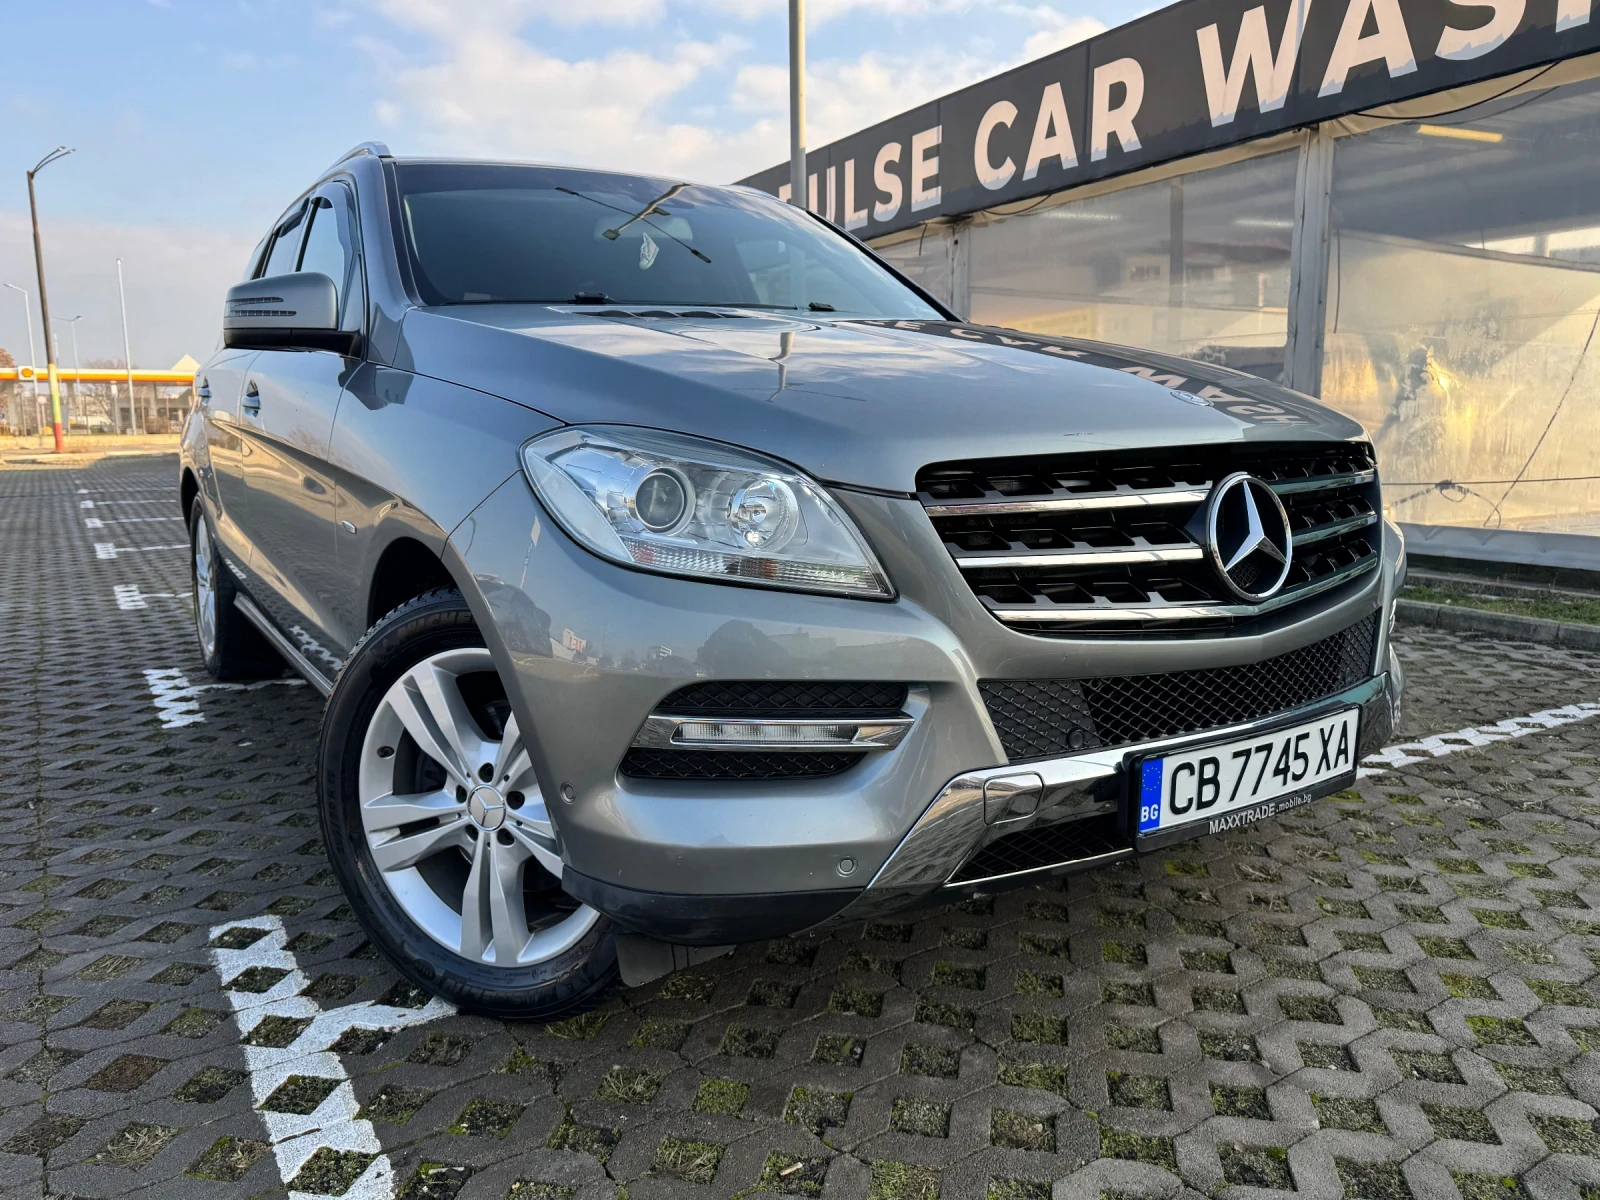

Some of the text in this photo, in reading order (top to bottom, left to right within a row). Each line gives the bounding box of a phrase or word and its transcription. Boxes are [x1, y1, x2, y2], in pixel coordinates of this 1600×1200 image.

[974, 57, 1145, 191] CAR
[1196, 0, 1592, 128] WAS
[1140, 804, 1159, 823] BG
[1169, 719, 1349, 815] CB 7745 XA
